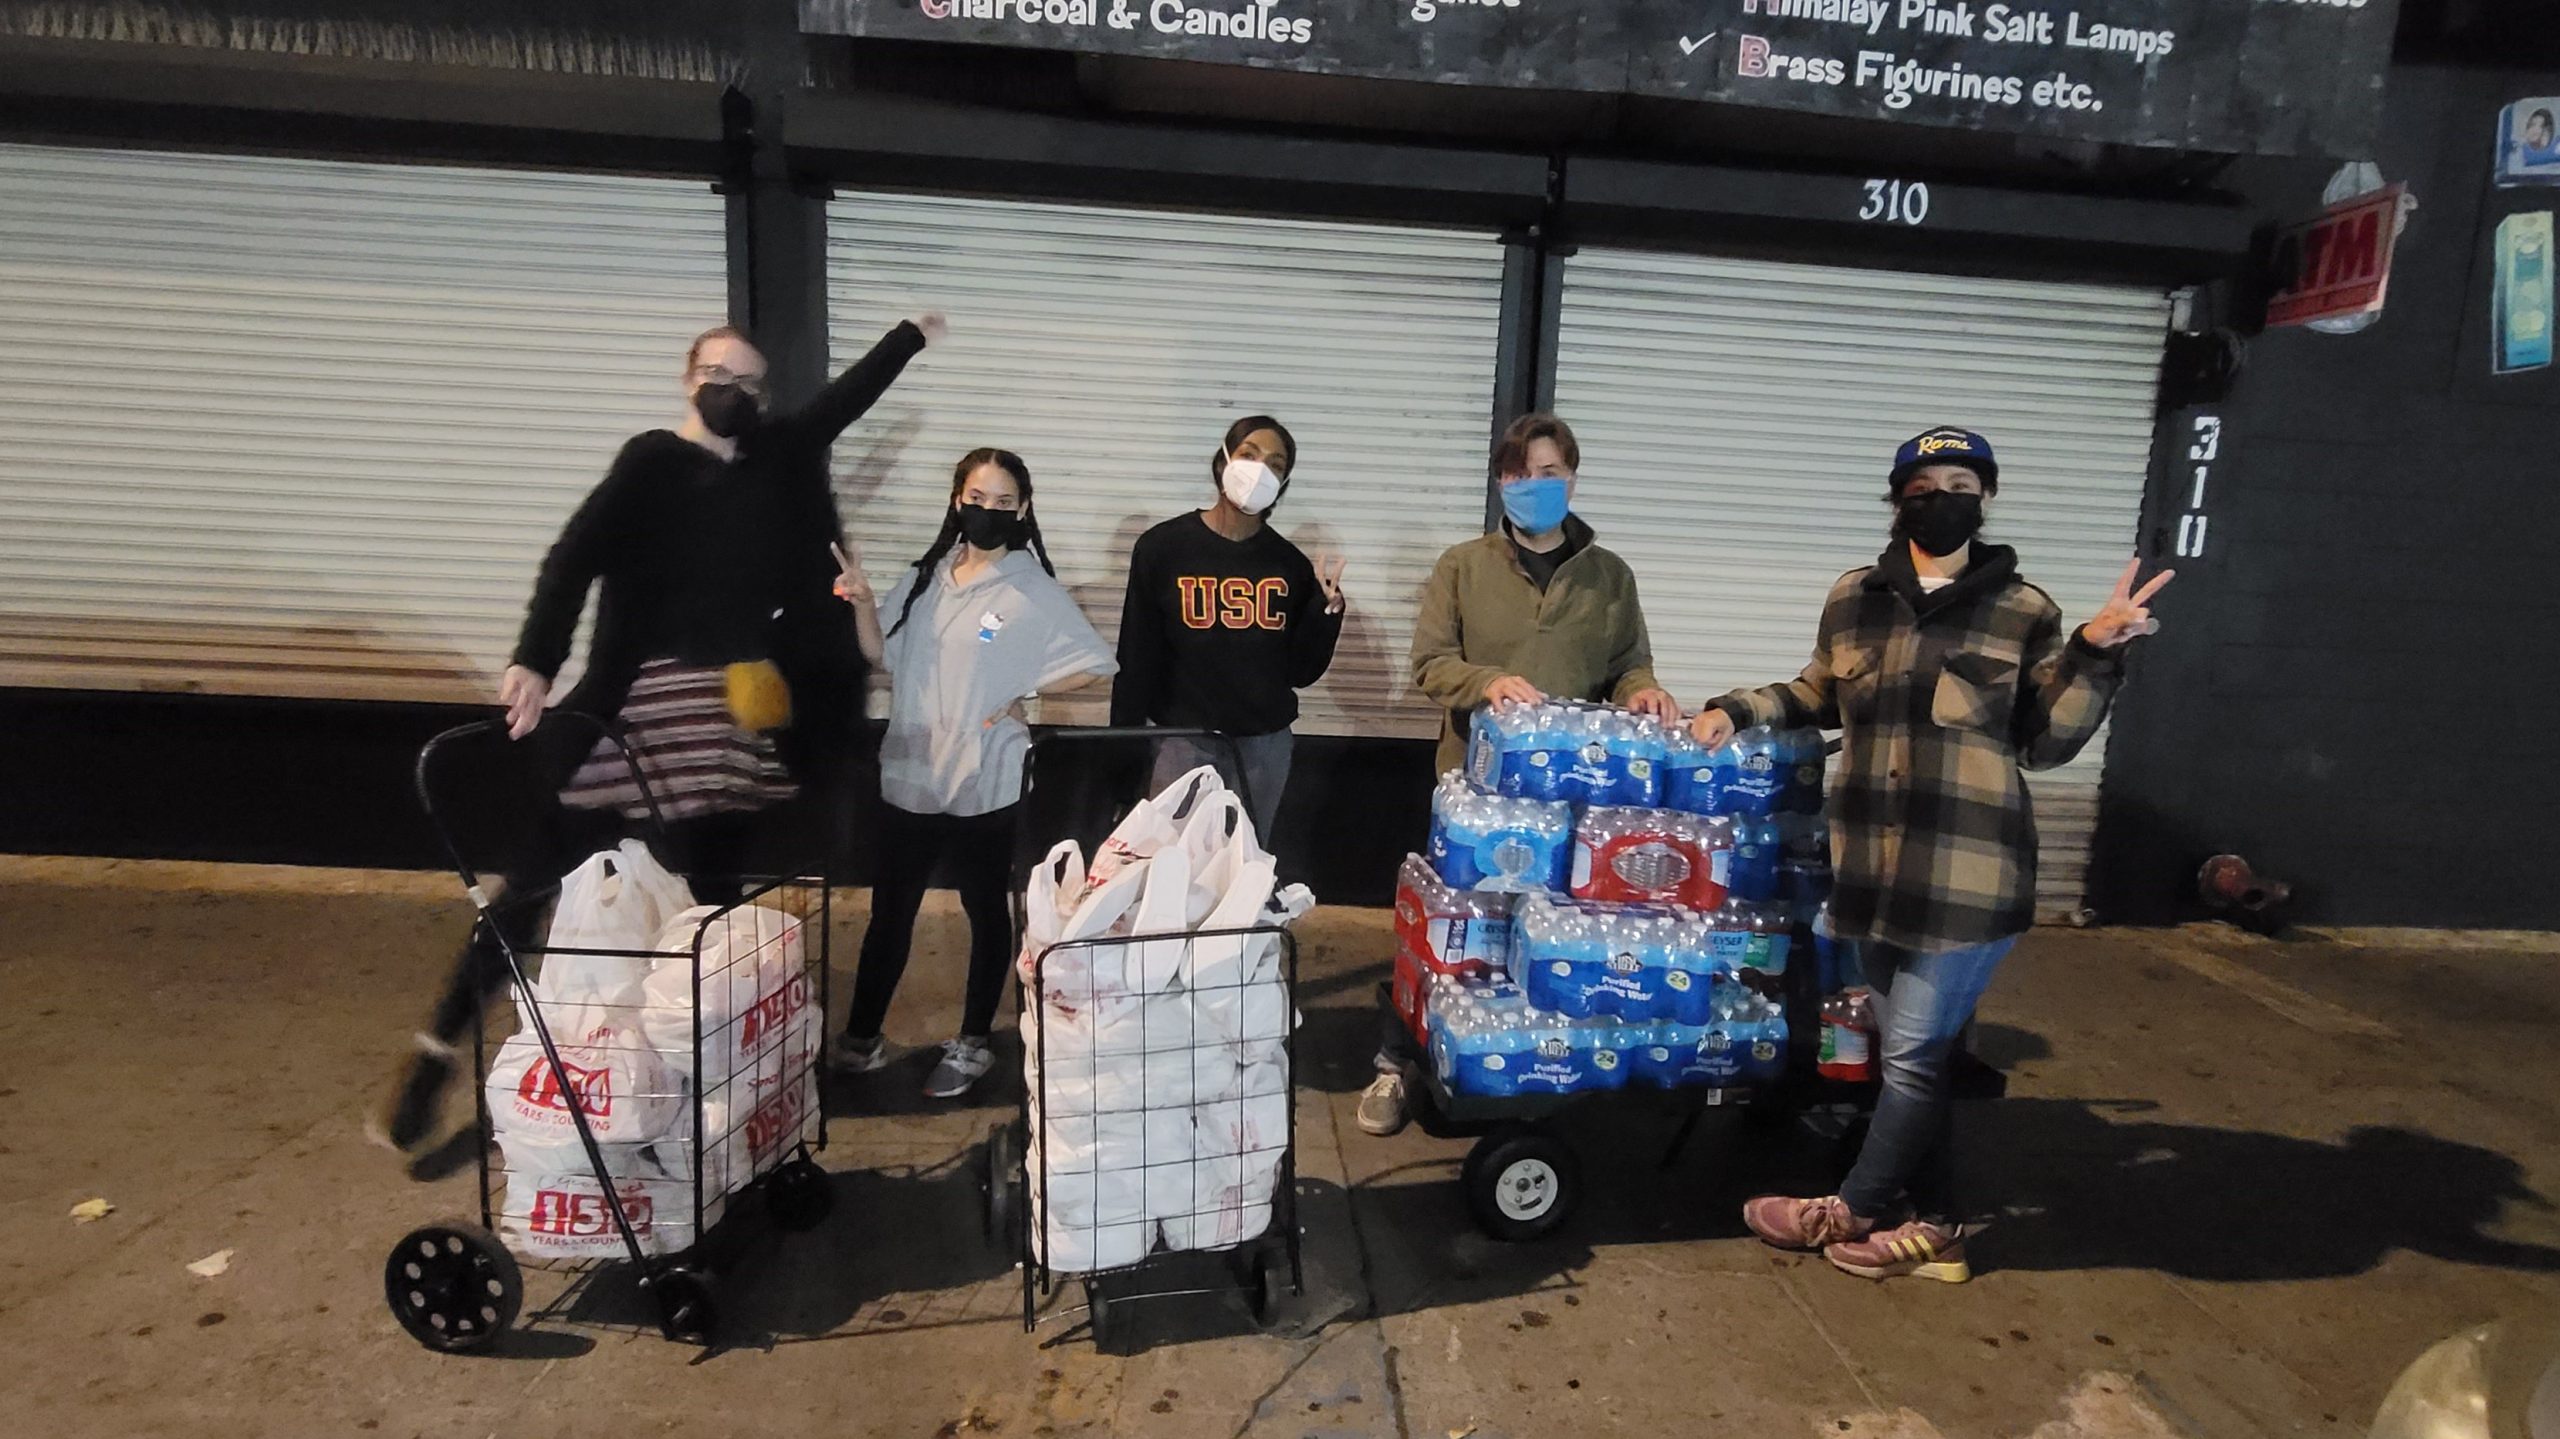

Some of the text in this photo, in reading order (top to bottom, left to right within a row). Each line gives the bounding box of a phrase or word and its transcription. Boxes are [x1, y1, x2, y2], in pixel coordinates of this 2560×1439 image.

[1106, 0, 1141, 29] &
[1149, 0, 1313, 44] Candles
[1898, 0, 1976, 37] Pink
[1983, 3, 2054, 45] Salt
[2065, 11, 2175, 63] Lamps
[1738, 34, 2103, 112] Brass Figurines etc.
[1859, 179, 1929, 226] 310
[1177, 577, 1289, 630] USC
[1713, 935, 1743, 946] EYSER
[1669, 973, 1688, 986] 24
[1533, 1053, 1615, 1074] Purified 24
[530, 1235, 568, 1246] YEARS
